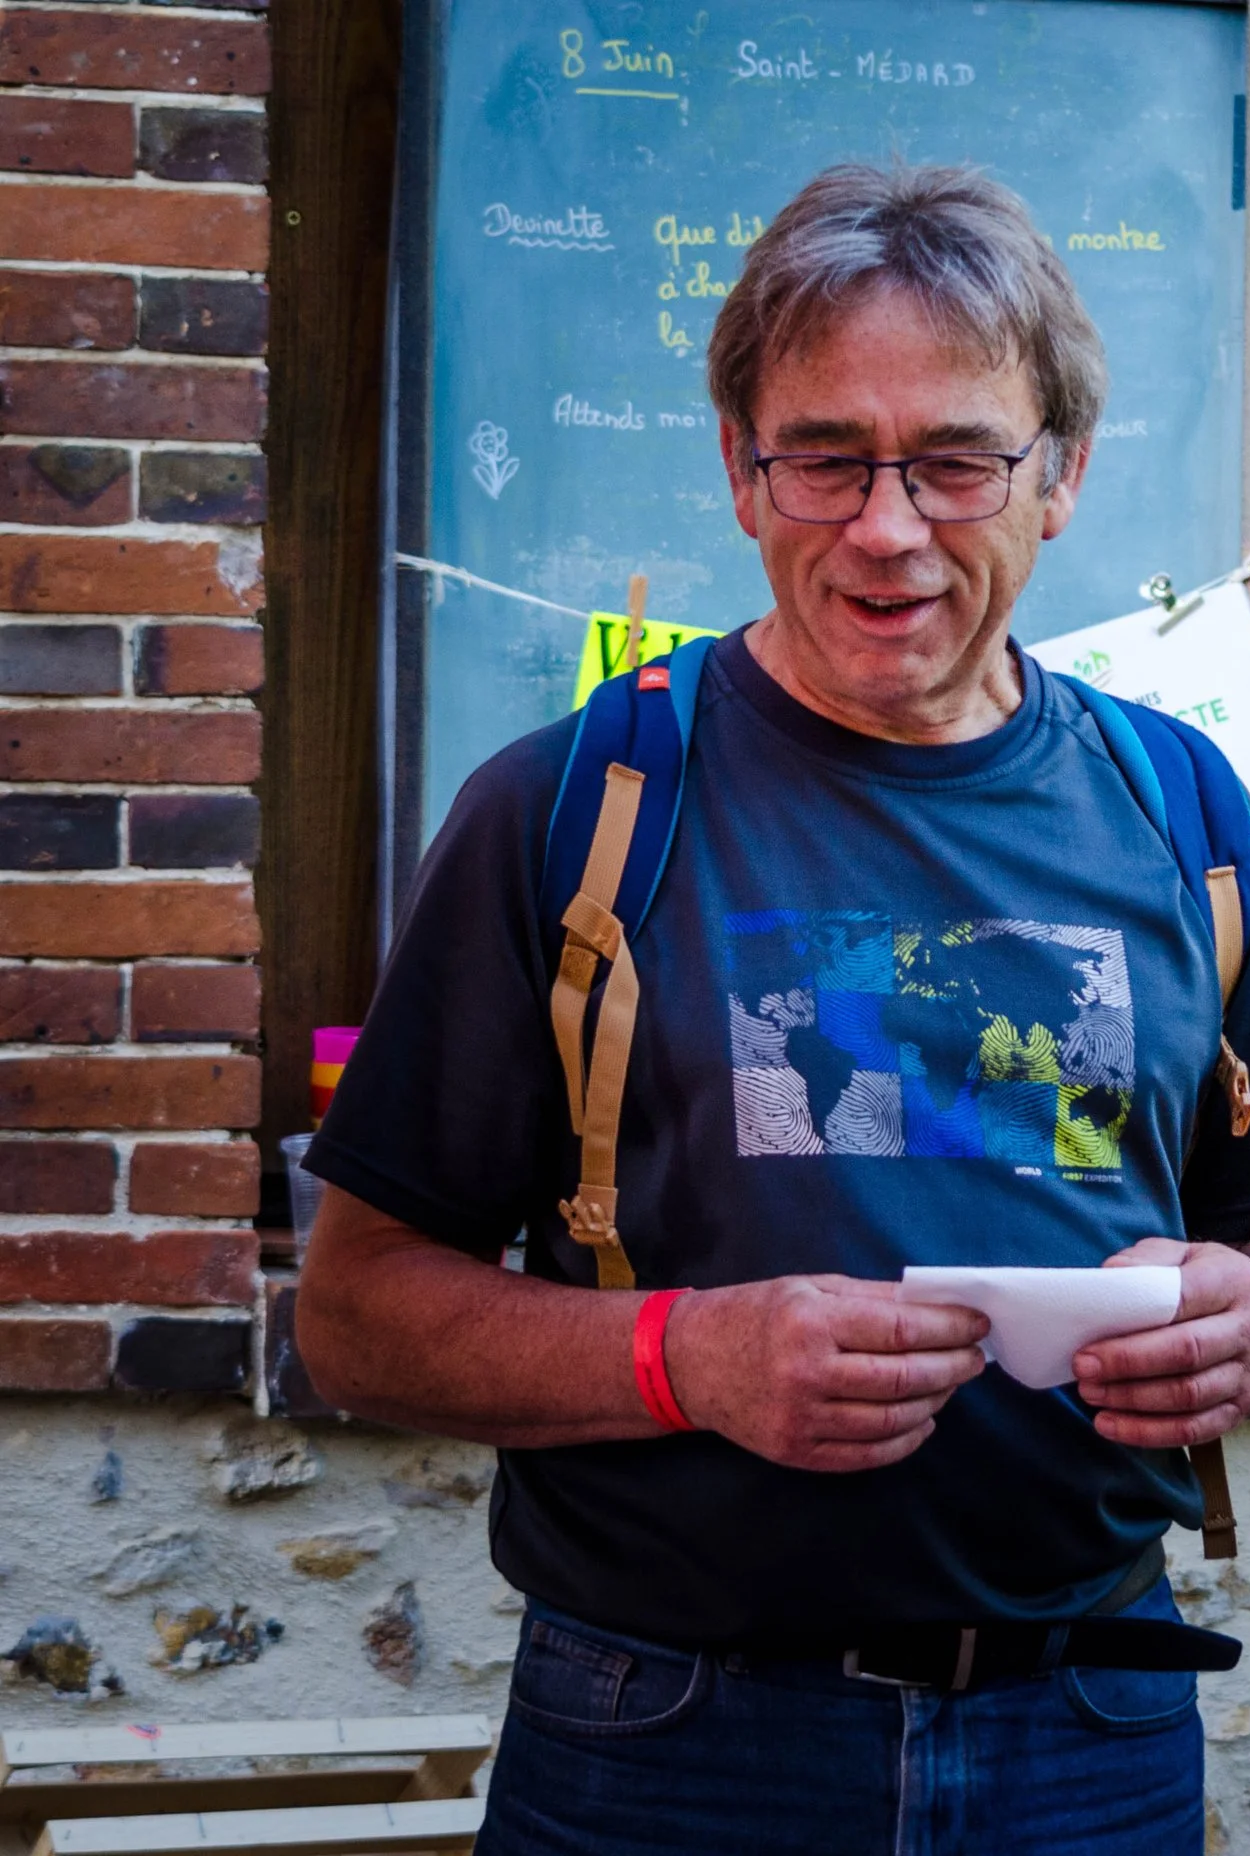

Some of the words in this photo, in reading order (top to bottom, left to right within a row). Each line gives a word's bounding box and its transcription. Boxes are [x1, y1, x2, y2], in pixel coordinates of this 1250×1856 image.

[560, 28, 585, 79] 8
[603, 39, 675, 77] Juin
[737, 40, 817, 79] Saint
[857, 48, 976, 87] MÉDARD
[482, 202, 611, 240] Devinette
[655, 213, 717, 267] Que
[1067, 220, 1167, 251] montre
[658, 310, 695, 348] la
[553, 393, 647, 431] Attends
[1014, 1166, 1043, 1176] WORLD
